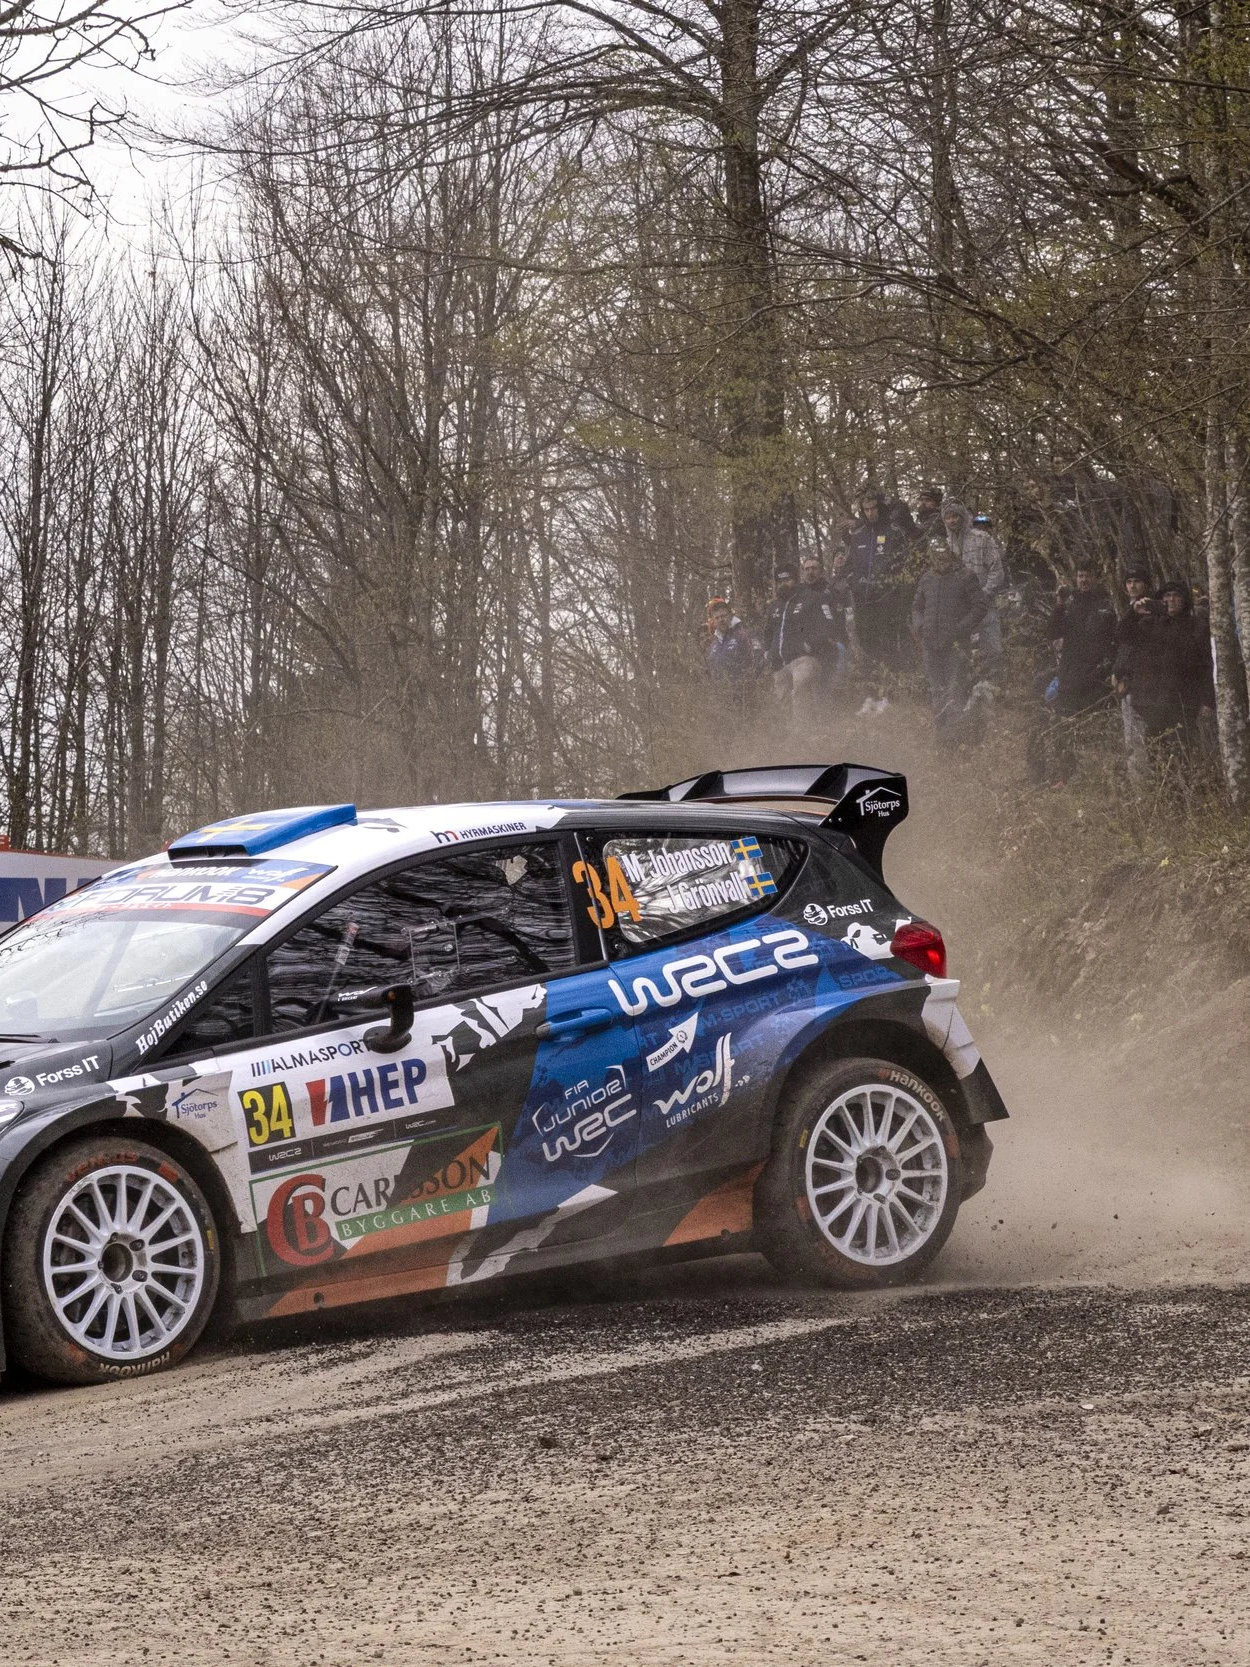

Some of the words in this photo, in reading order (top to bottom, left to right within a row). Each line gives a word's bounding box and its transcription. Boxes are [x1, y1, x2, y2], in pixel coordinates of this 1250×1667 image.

[864, 799, 901, 814] Sjötorps
[877, 810, 890, 818] Hus
[459, 821, 527, 840] HYRMASKINER
[648, 841, 734, 879] Johansson
[571, 854, 643, 930] 34
[677, 871, 749, 912] Grönvall
[826, 903, 862, 919] Forss
[859, 898, 874, 913] IT
[608, 929, 820, 1017] WRC2
[35, 1063, 84, 1087] Forss
[83, 1055, 101, 1073] IT
[649, 1041, 678, 1067] CHAMPION
[347, 1058, 428, 1117] HEP
[543, 1078, 623, 1133] JUNIOR
[564, 1079, 589, 1100] FIA
[241, 1084, 293, 1145] 34
[541, 1093, 638, 1162] WRC
[665, 1092, 720, 1129] LUBRICANTS
[269, 1147, 302, 1162] WRC2
[341, 1198, 450, 1238] BYGGARE
[465, 1189, 492, 1207] AB
